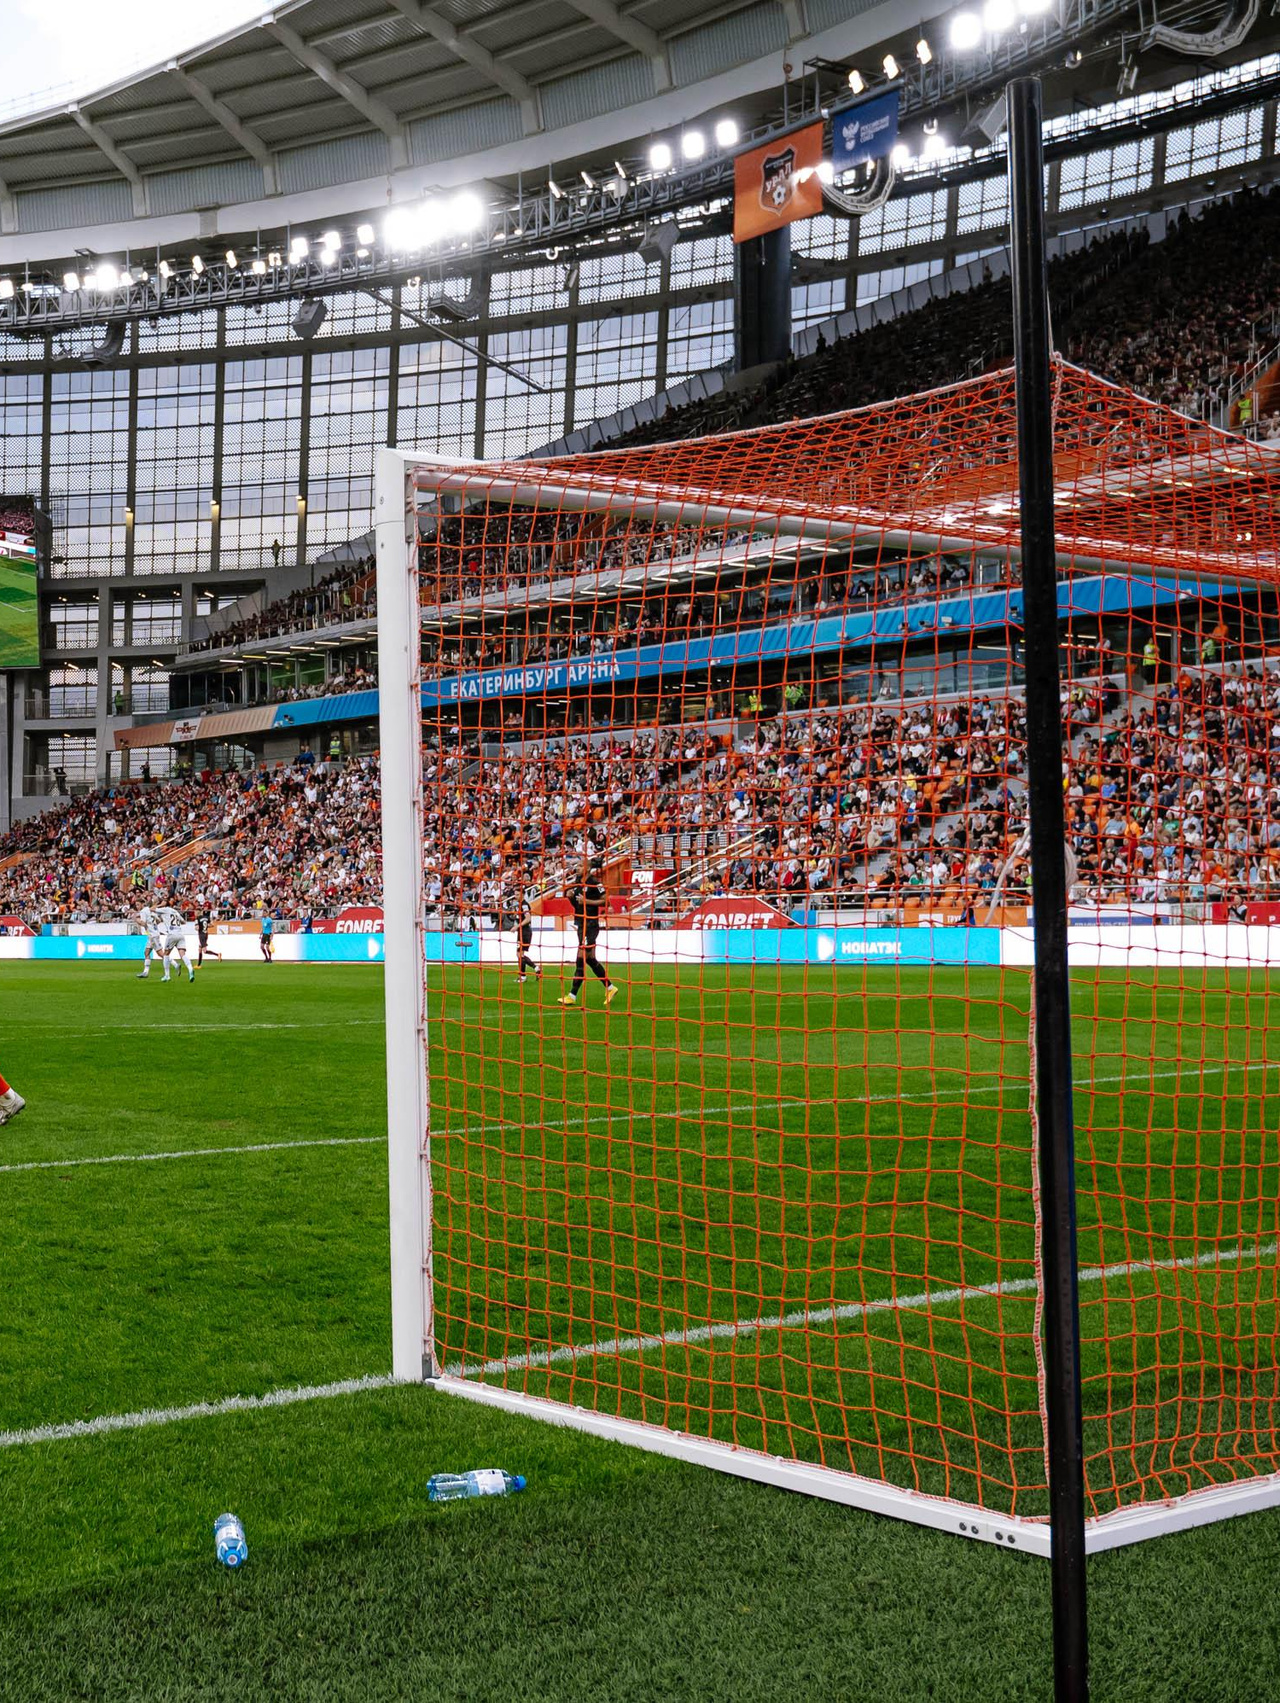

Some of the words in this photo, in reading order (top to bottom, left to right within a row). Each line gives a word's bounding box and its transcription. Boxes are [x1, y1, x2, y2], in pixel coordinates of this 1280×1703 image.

[765, 161, 792, 193] УРАЛ
[451, 667, 562, 699] ЕКАТЕРИНБУРГ
[568, 657, 620, 682] АРЕНА
